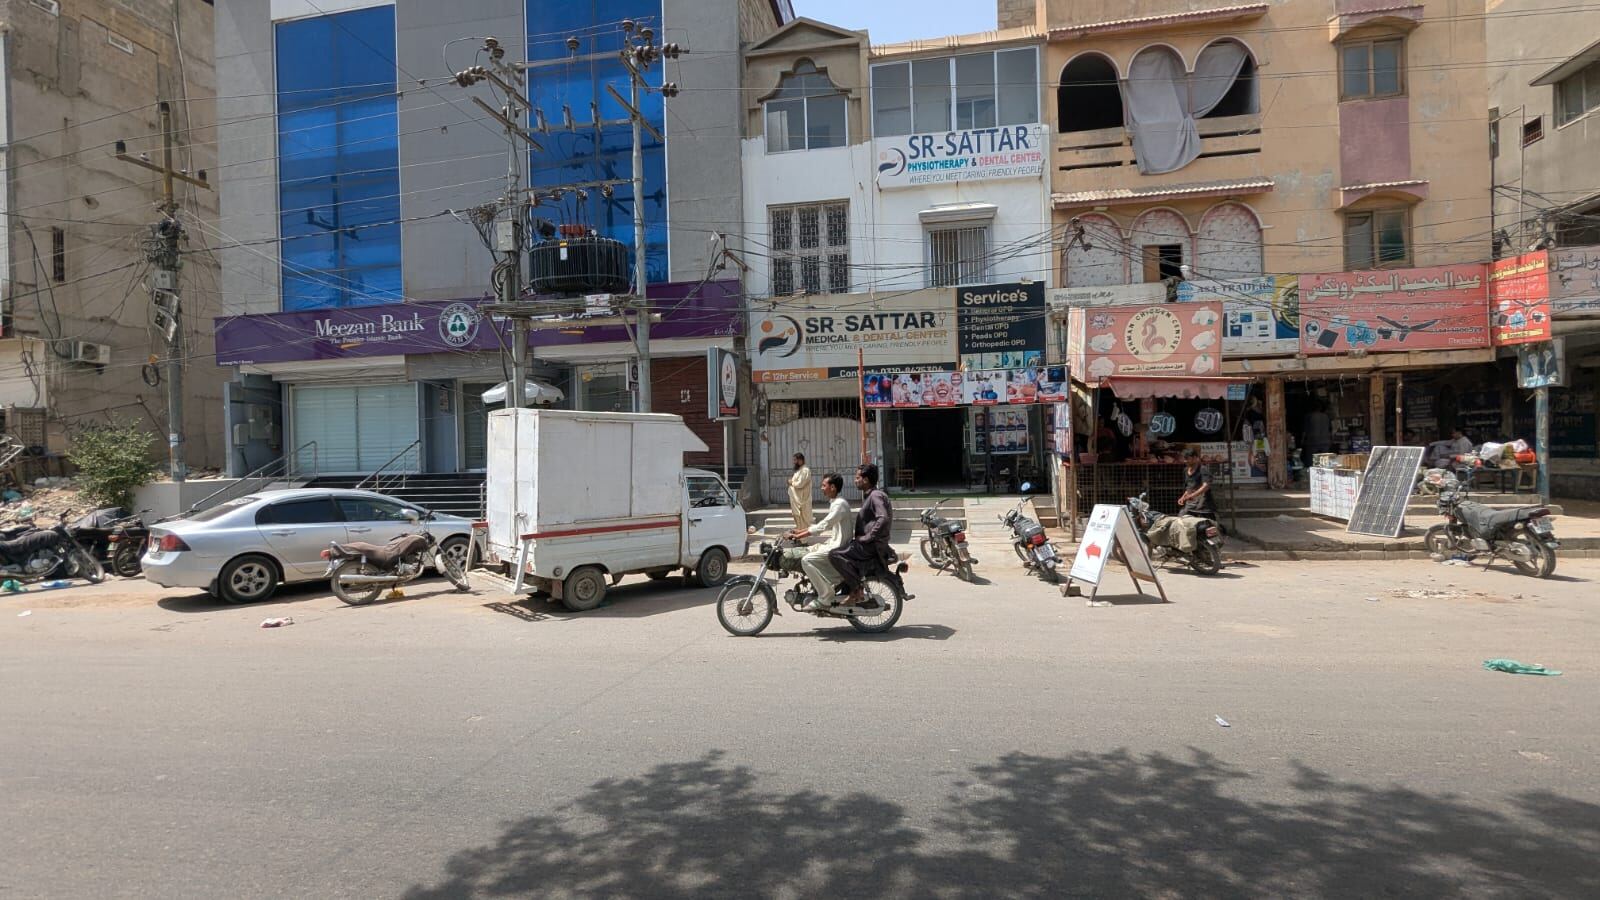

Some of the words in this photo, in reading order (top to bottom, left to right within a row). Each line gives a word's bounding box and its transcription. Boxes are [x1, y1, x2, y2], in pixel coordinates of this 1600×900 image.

[907, 158, 969, 173] PHYSIOTHERAPY
[979, 154, 1008, 166] DENTAL
[1011, 152, 1041, 164] CENTER
[932, 172, 944, 182] YOU
[945, 171, 962, 181] MEET
[988, 168, 1017, 178] FRIENDLY
[963, 288, 1029, 305] Service's
[314, 318, 376, 338] Meezan
[381, 312, 425, 333] Bank
[971, 315, 1020, 324] Physiotherapy
[971, 323, 993, 331] Dental
[994, 322, 1009, 331] OPD
[805, 333, 849, 345] MEDICAL
[860, 331, 903, 342] DENTAL
[905, 329, 948, 341] CENTER
[971, 340, 1010, 349] Orthopedic
[789, 371, 819, 380] Service
